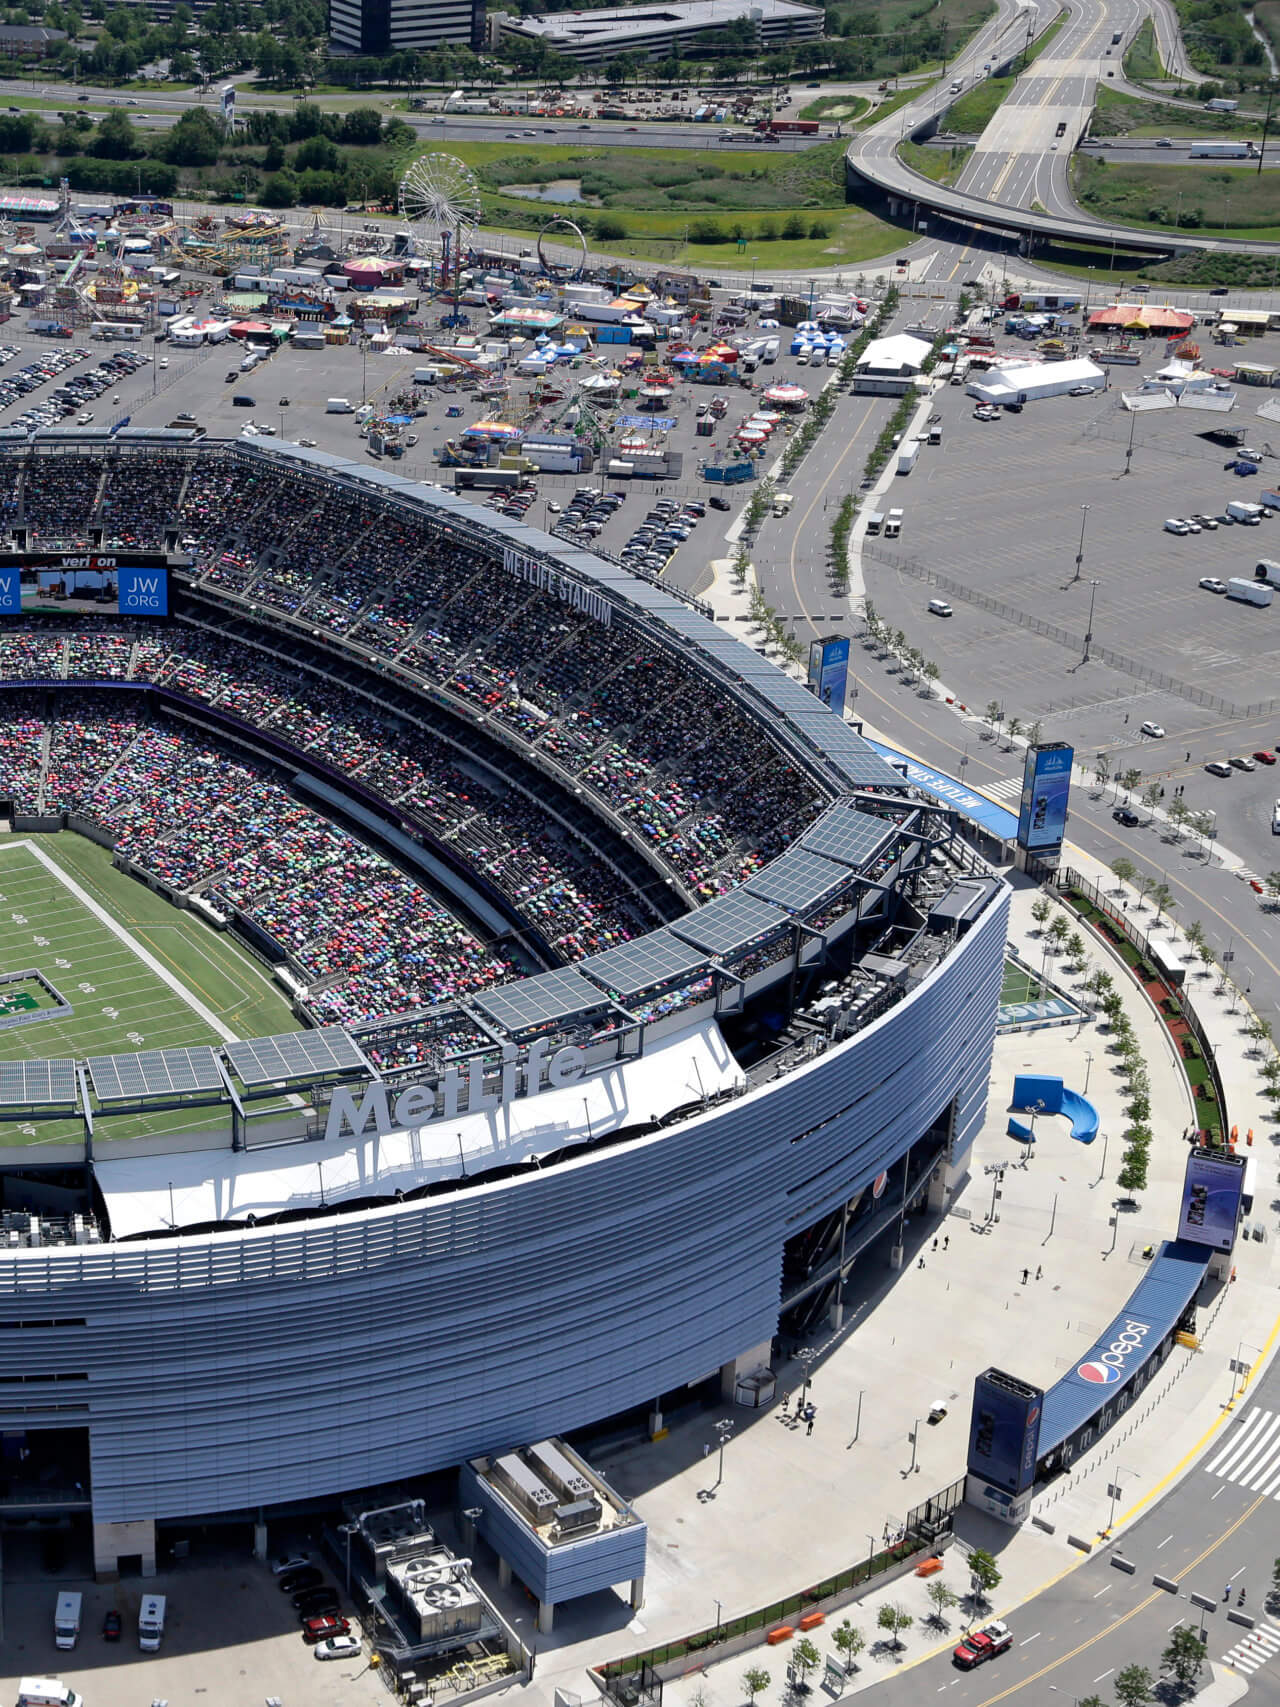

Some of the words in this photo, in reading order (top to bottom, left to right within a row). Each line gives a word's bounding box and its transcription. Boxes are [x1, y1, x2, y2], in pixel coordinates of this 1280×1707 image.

[62, 556, 116, 569] verizon
[127, 577, 159, 594] JW
[503, 549, 556, 595] METLIFE
[559, 578, 612, 629] STADIUM
[124, 595, 160, 608] .ORG
[926, 779, 983, 808] METLIFE
[78, 983, 96, 993] 50
[996, 1001, 1064, 1023] Met
[324, 1037, 586, 1141] MetLife
[1101, 1320, 1151, 1368] pepsi
[1024, 1430, 1034, 1470] pepsi
